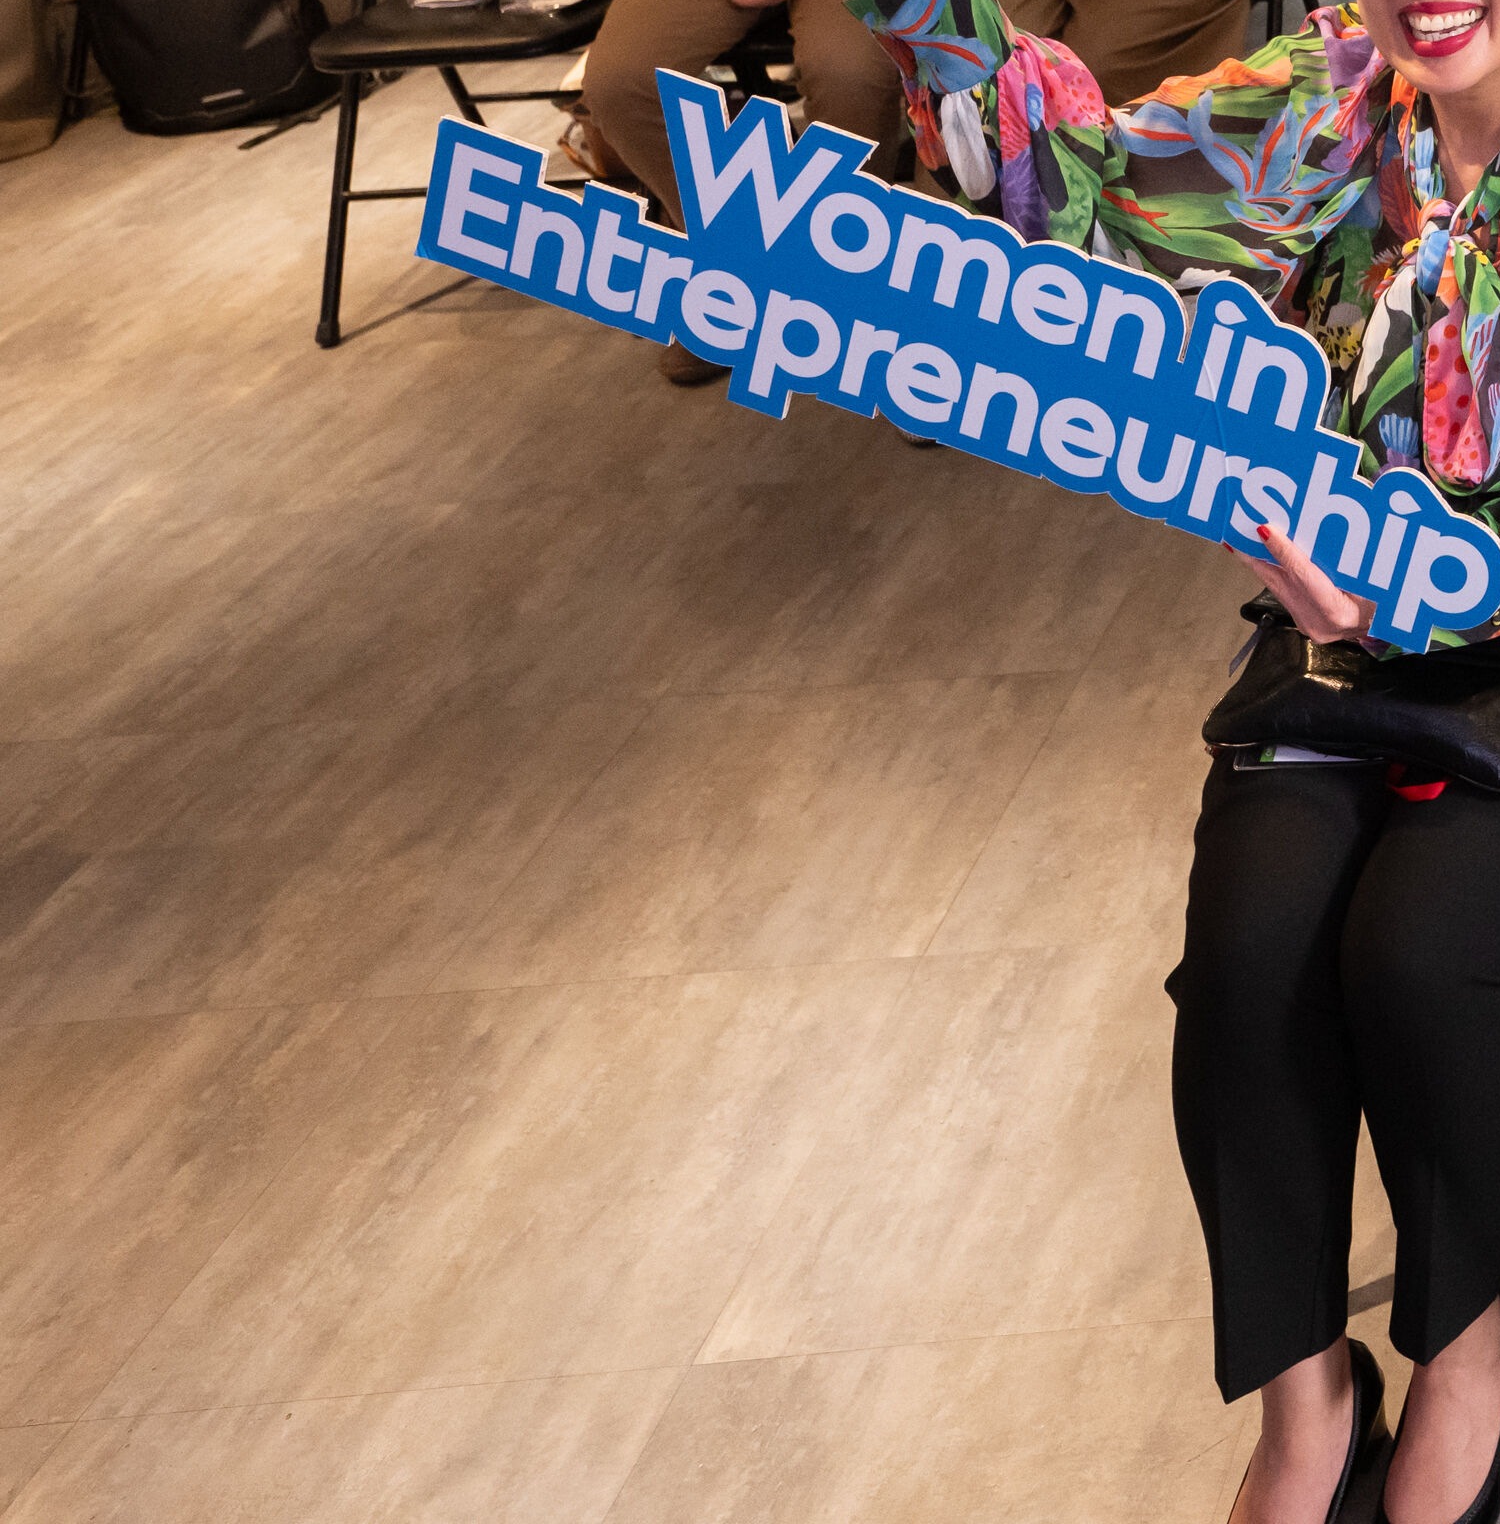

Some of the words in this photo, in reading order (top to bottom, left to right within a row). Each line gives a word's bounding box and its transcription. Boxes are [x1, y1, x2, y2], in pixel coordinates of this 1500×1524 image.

[436, 142, 1490, 632] Entrepreneurship
[679, 97, 1167, 379] Women
[1195, 299, 1309, 431] in
